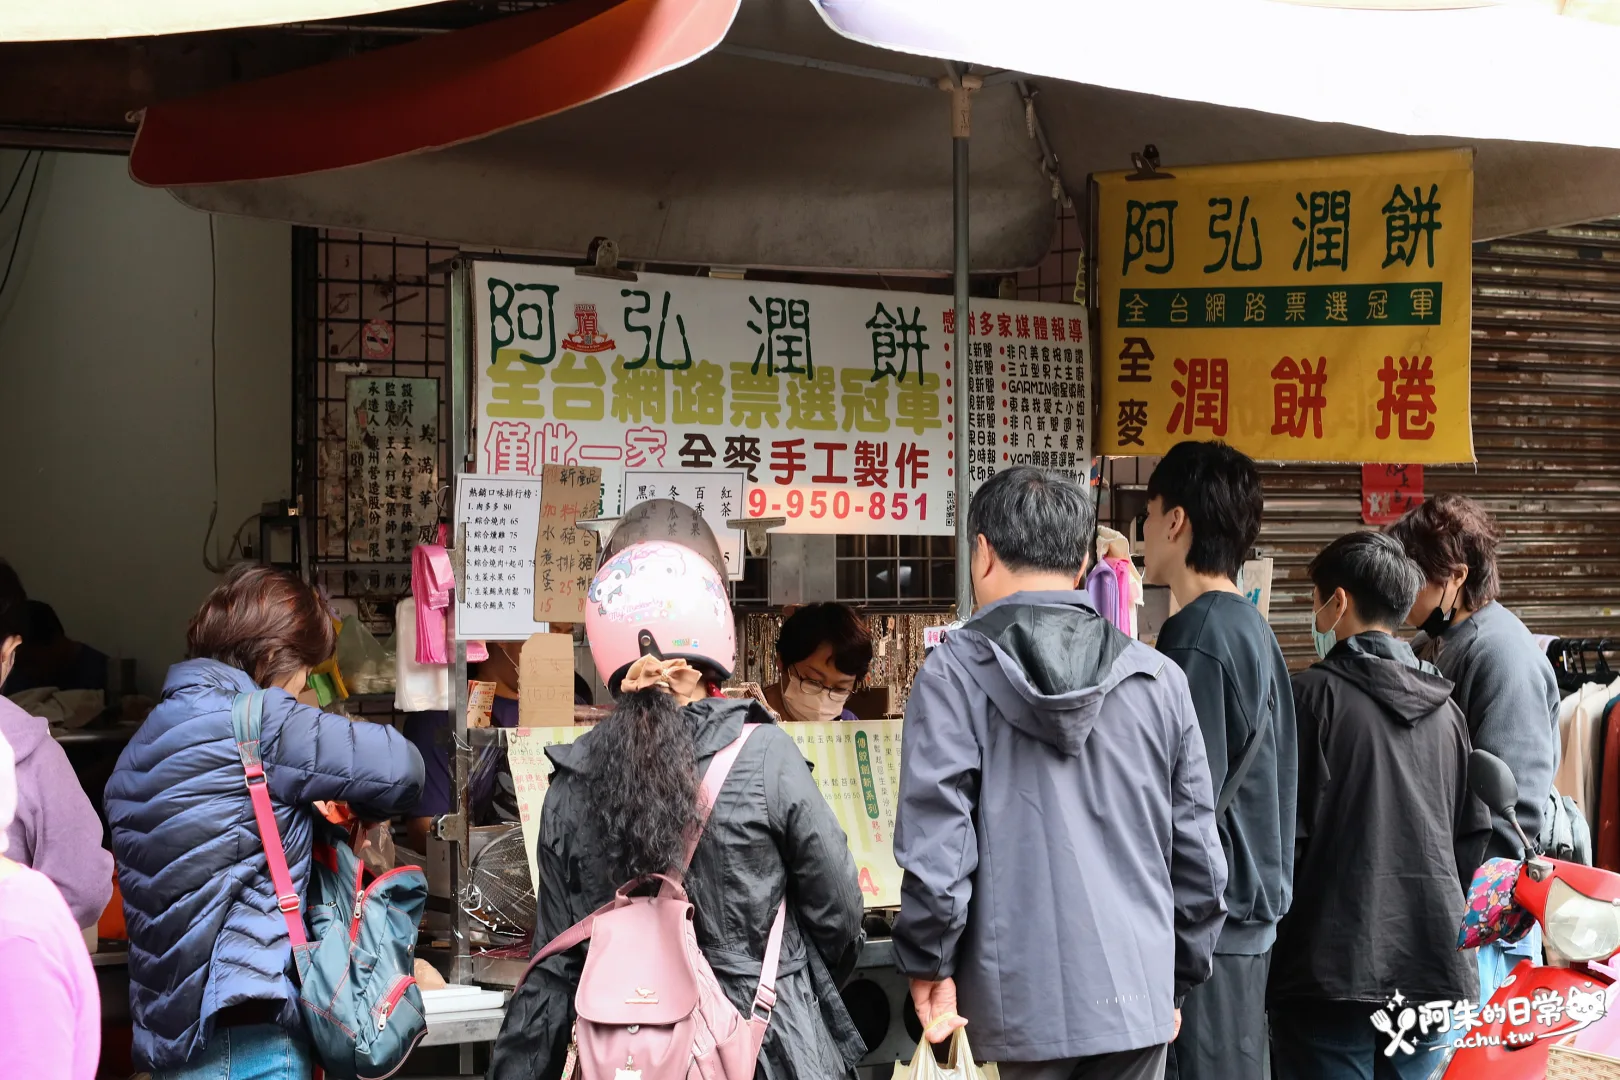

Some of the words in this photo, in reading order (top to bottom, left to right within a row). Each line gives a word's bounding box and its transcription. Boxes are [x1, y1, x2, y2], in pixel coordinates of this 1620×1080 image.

[1122, 183, 1442, 276] 阿弘潤餅
[1125, 288, 1435, 323] 全台網路票選冠軍
[487, 277, 930, 386] 阿弘潤餅
[1008, 362, 1084, 381] 三立型男大主廚
[486, 349, 942, 435] 全台網路票選冠軍
[1117, 336, 1155, 447] 全麥
[1166, 355, 1437, 440] 潤餅捲
[1009, 397, 1085, 416] 東森我愛大小姐
[1009, 415, 1085, 433] 非凡新聞週刊
[1010, 432, 1084, 451] 非凡大探索
[476, 502, 499, 512] 肉多多
[720, 486, 732, 518] 紅茶
[748, 488, 927, 521] 9-950-851
[475, 516, 506, 526] 綜合燒肉
[510, 517, 519, 525] 65
[509, 545, 517, 553] 75
[507, 573, 516, 581] 65
[508, 601, 516, 609] 75
